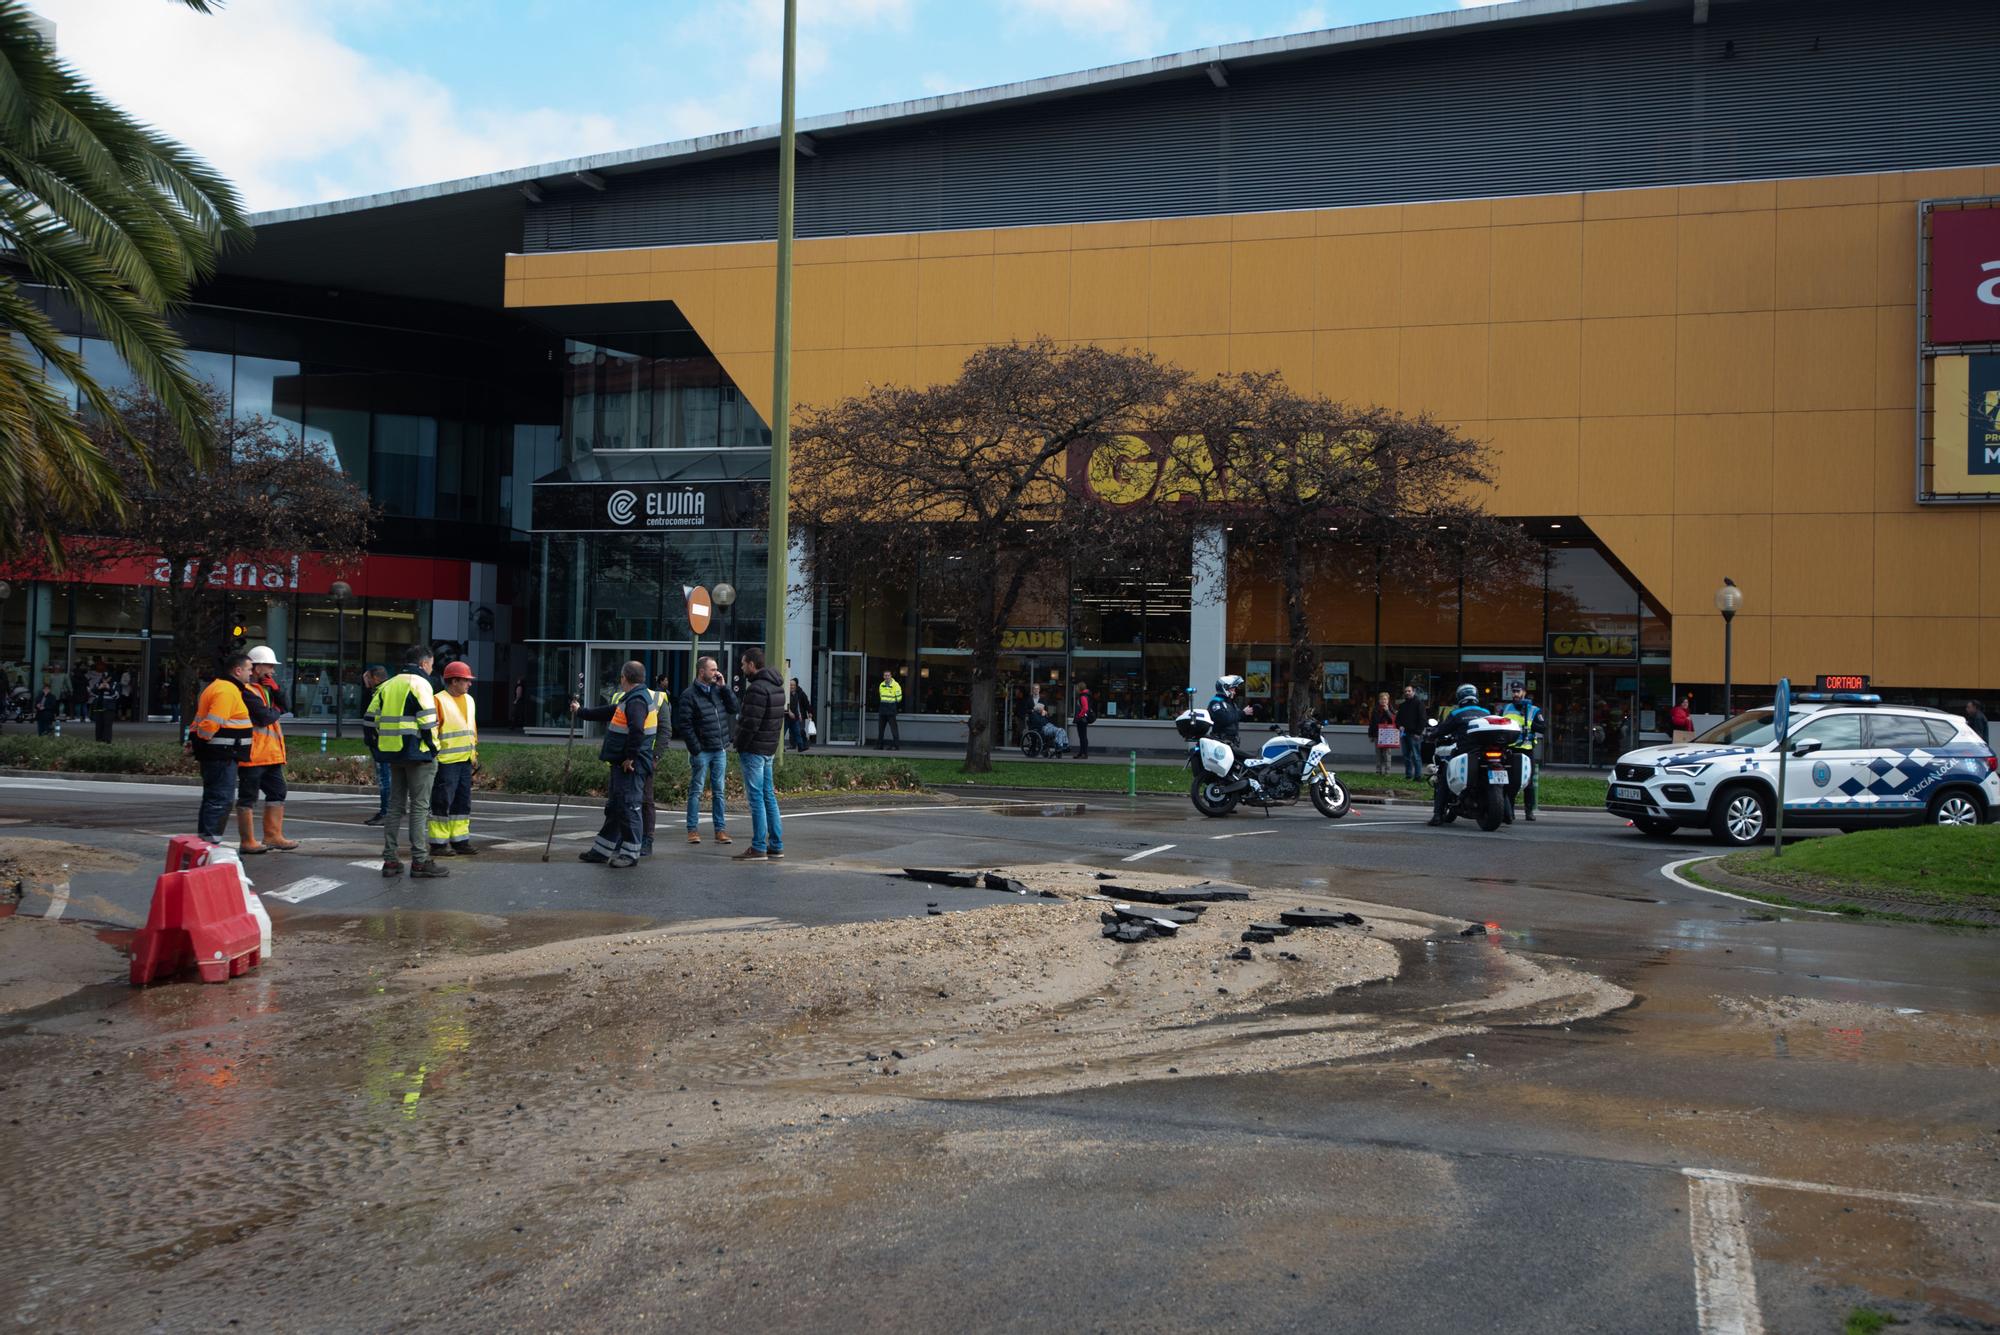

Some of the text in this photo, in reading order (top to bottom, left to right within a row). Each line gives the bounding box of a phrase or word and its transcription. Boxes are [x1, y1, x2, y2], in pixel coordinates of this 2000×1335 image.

[646, 486, 705, 515] ELVIÑA
[153, 554, 300, 589] arenal
[1000, 630, 1065, 649] GADIS
[1554, 635, 1633, 655] GADIS
[1826, 676, 1863, 689] CORTADA
[1902, 757, 1960, 801] POLICÍA LOCAL
